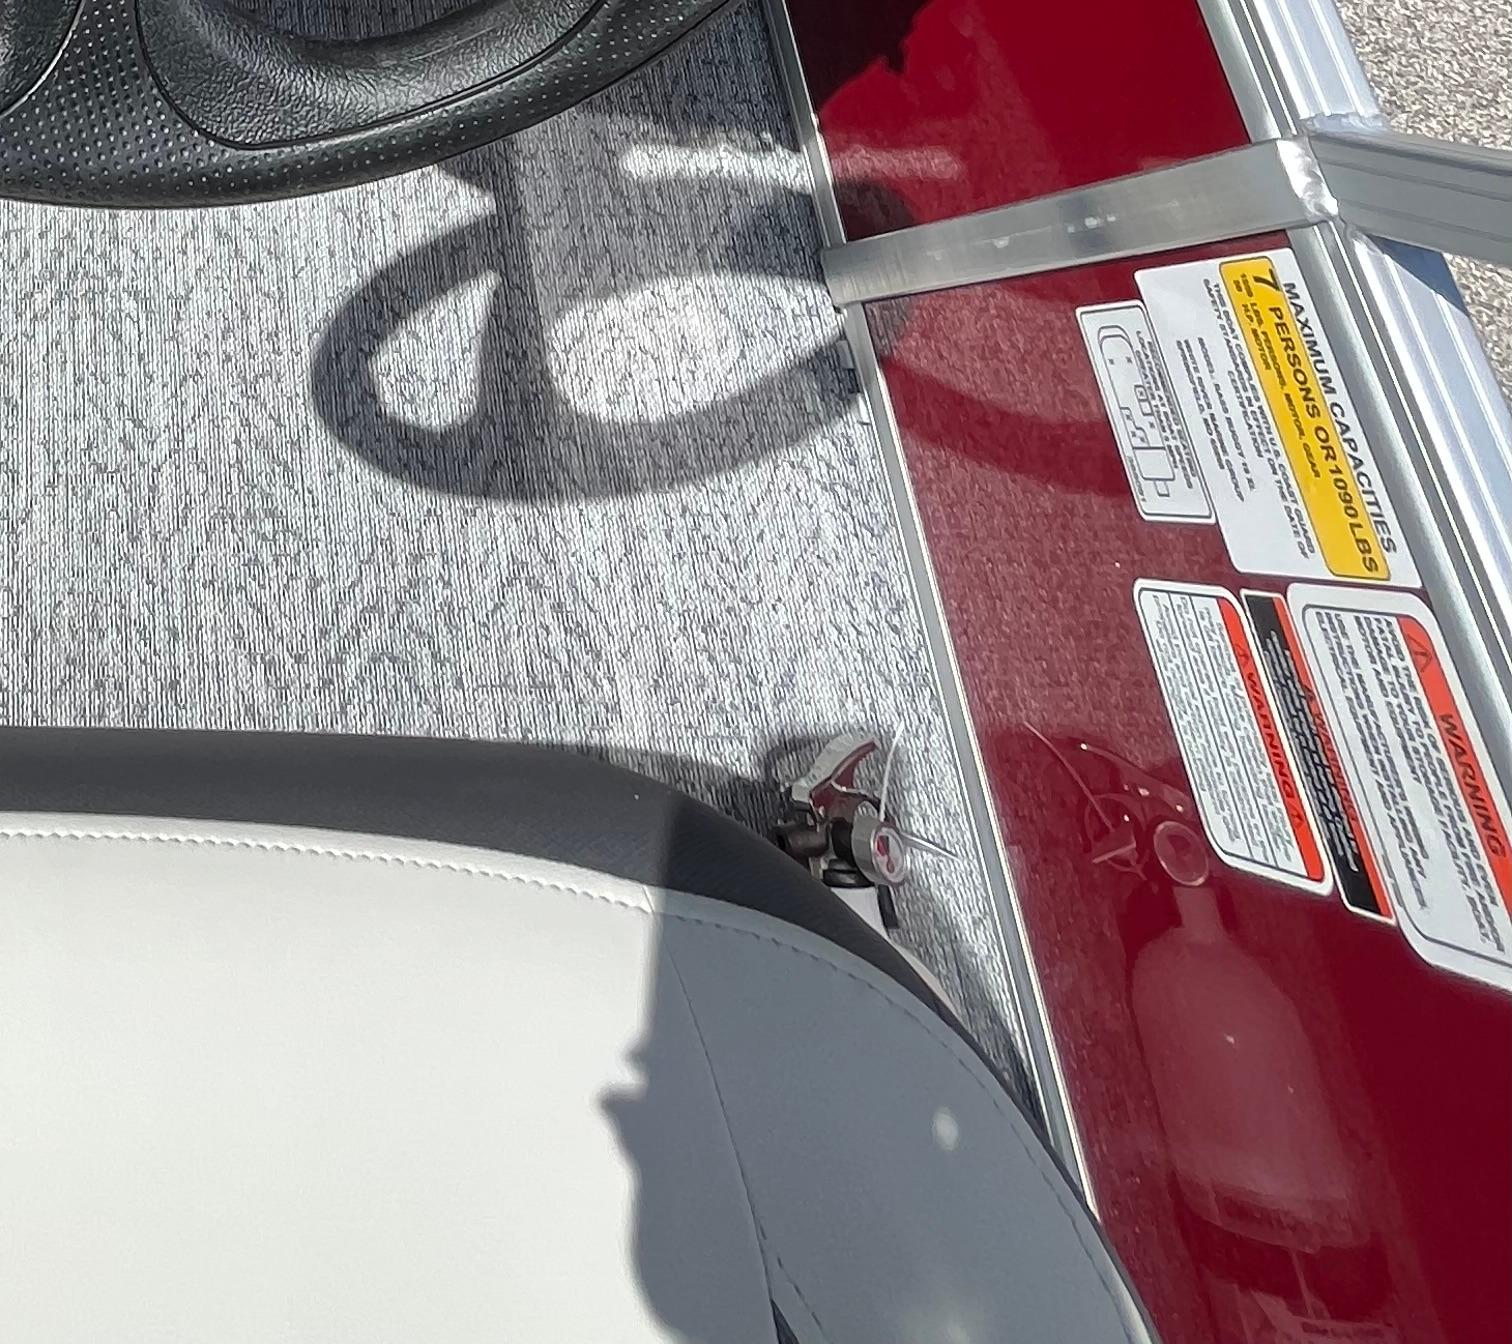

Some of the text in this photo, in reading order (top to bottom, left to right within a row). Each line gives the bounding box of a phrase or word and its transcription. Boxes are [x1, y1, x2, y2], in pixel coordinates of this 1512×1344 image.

[1251, 268, 1380, 572] 7 PERSONS OR 1090 LBS
[1282, 282, 1398, 553] MAXIMUM CAPACITIES
[1244, 671, 1295, 799] WARNING
[1437, 713, 1507, 856] WARNING
